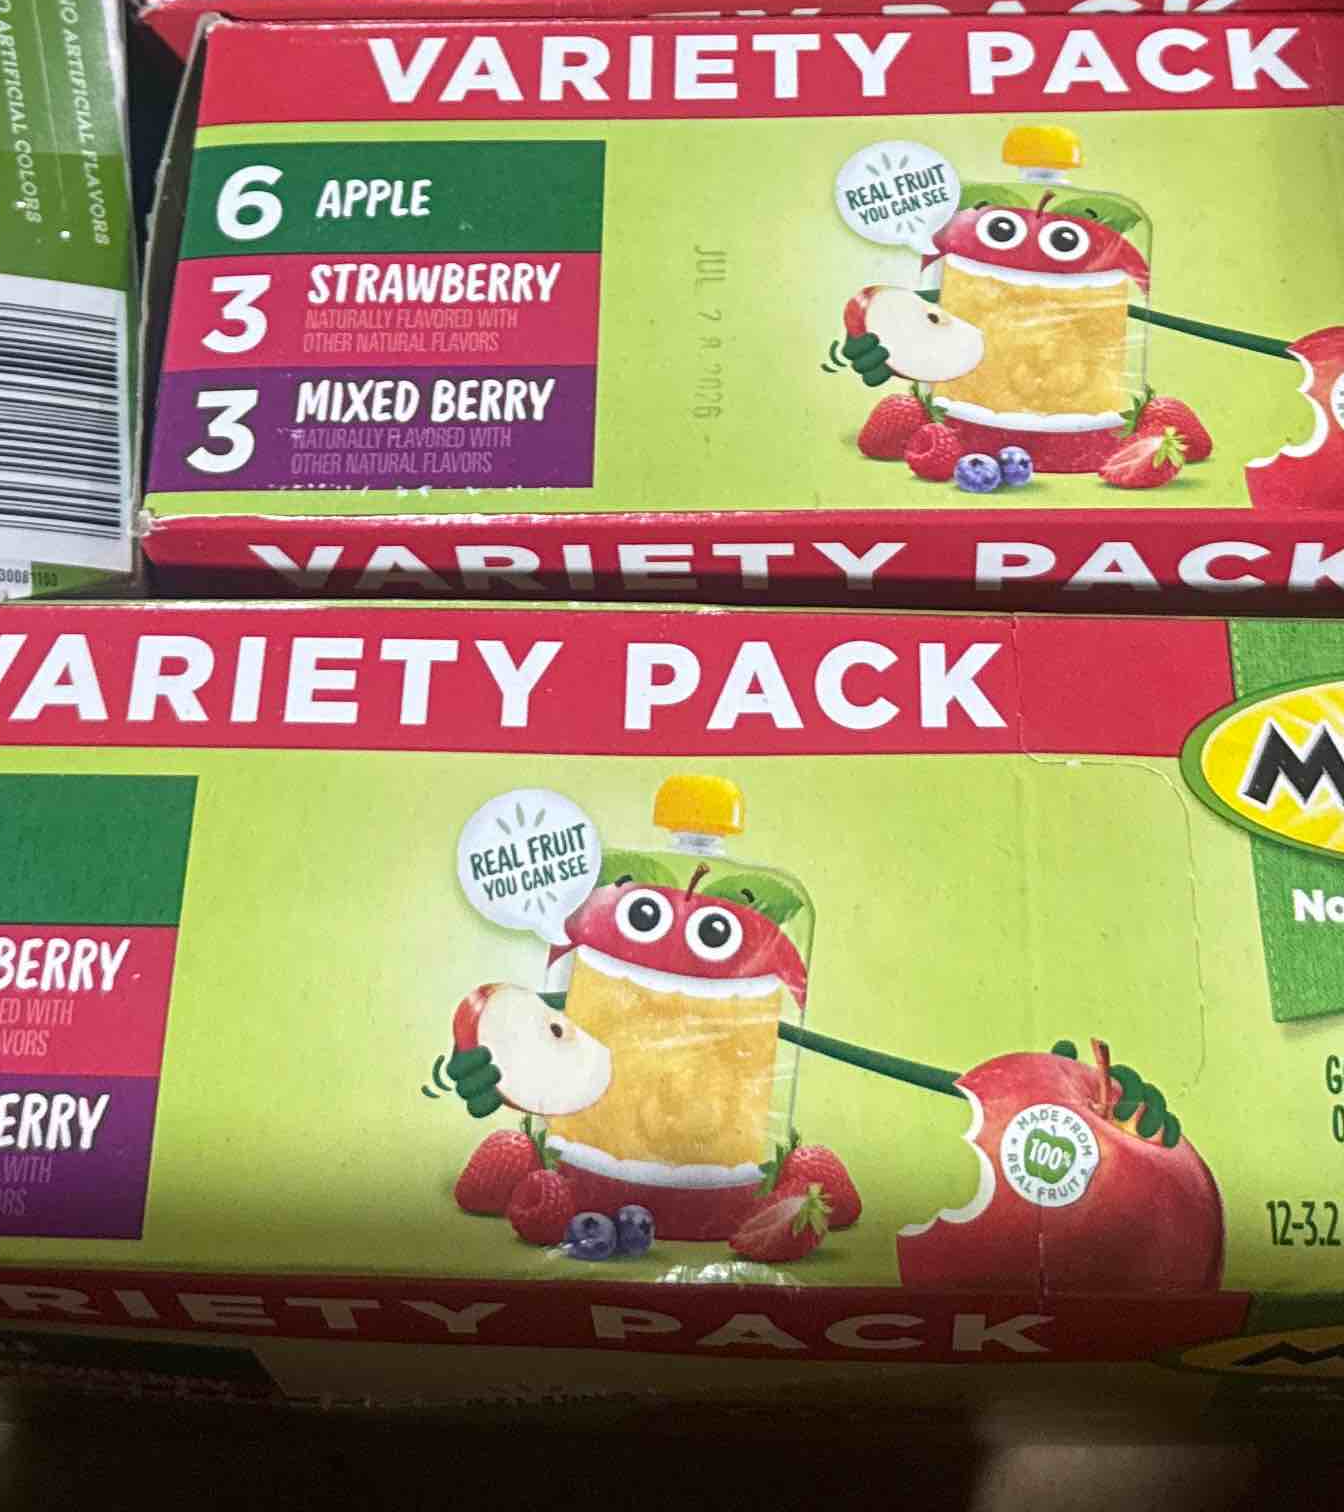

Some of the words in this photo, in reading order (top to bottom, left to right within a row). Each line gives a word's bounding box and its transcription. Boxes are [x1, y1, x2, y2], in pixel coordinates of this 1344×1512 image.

[368, 32, 912, 103] VARIETY
[967, 27, 1310, 95] PACK
[62, 28, 96, 144] ARTIFICIAL
[80, 148, 110, 246] FLAVORS
[14, 138, 43, 223] COLORS
[216, 165, 284, 241] 6
[316, 178, 433, 219] APPLE
[693, 244, 727, 294] JUL
[201, 273, 272, 355] 3
[307, 262, 561, 304] STRAWBERRY
[185, 388, 260, 474] 3
[296, 379, 420, 424] MIXED
[431, 378, 556, 424] BERRY
[624, 640, 1007, 731] PACK
[470, 846, 524, 875] REAL
[528, 824, 588, 866] FRUIT
[483, 876, 519, 899] YOU
[521, 867, 555, 888] CAN
[559, 855, 589, 878] SEE
[26, 999, 74, 1025] WITH
[1266, 1200, 1341, 1247] 12-3.2
